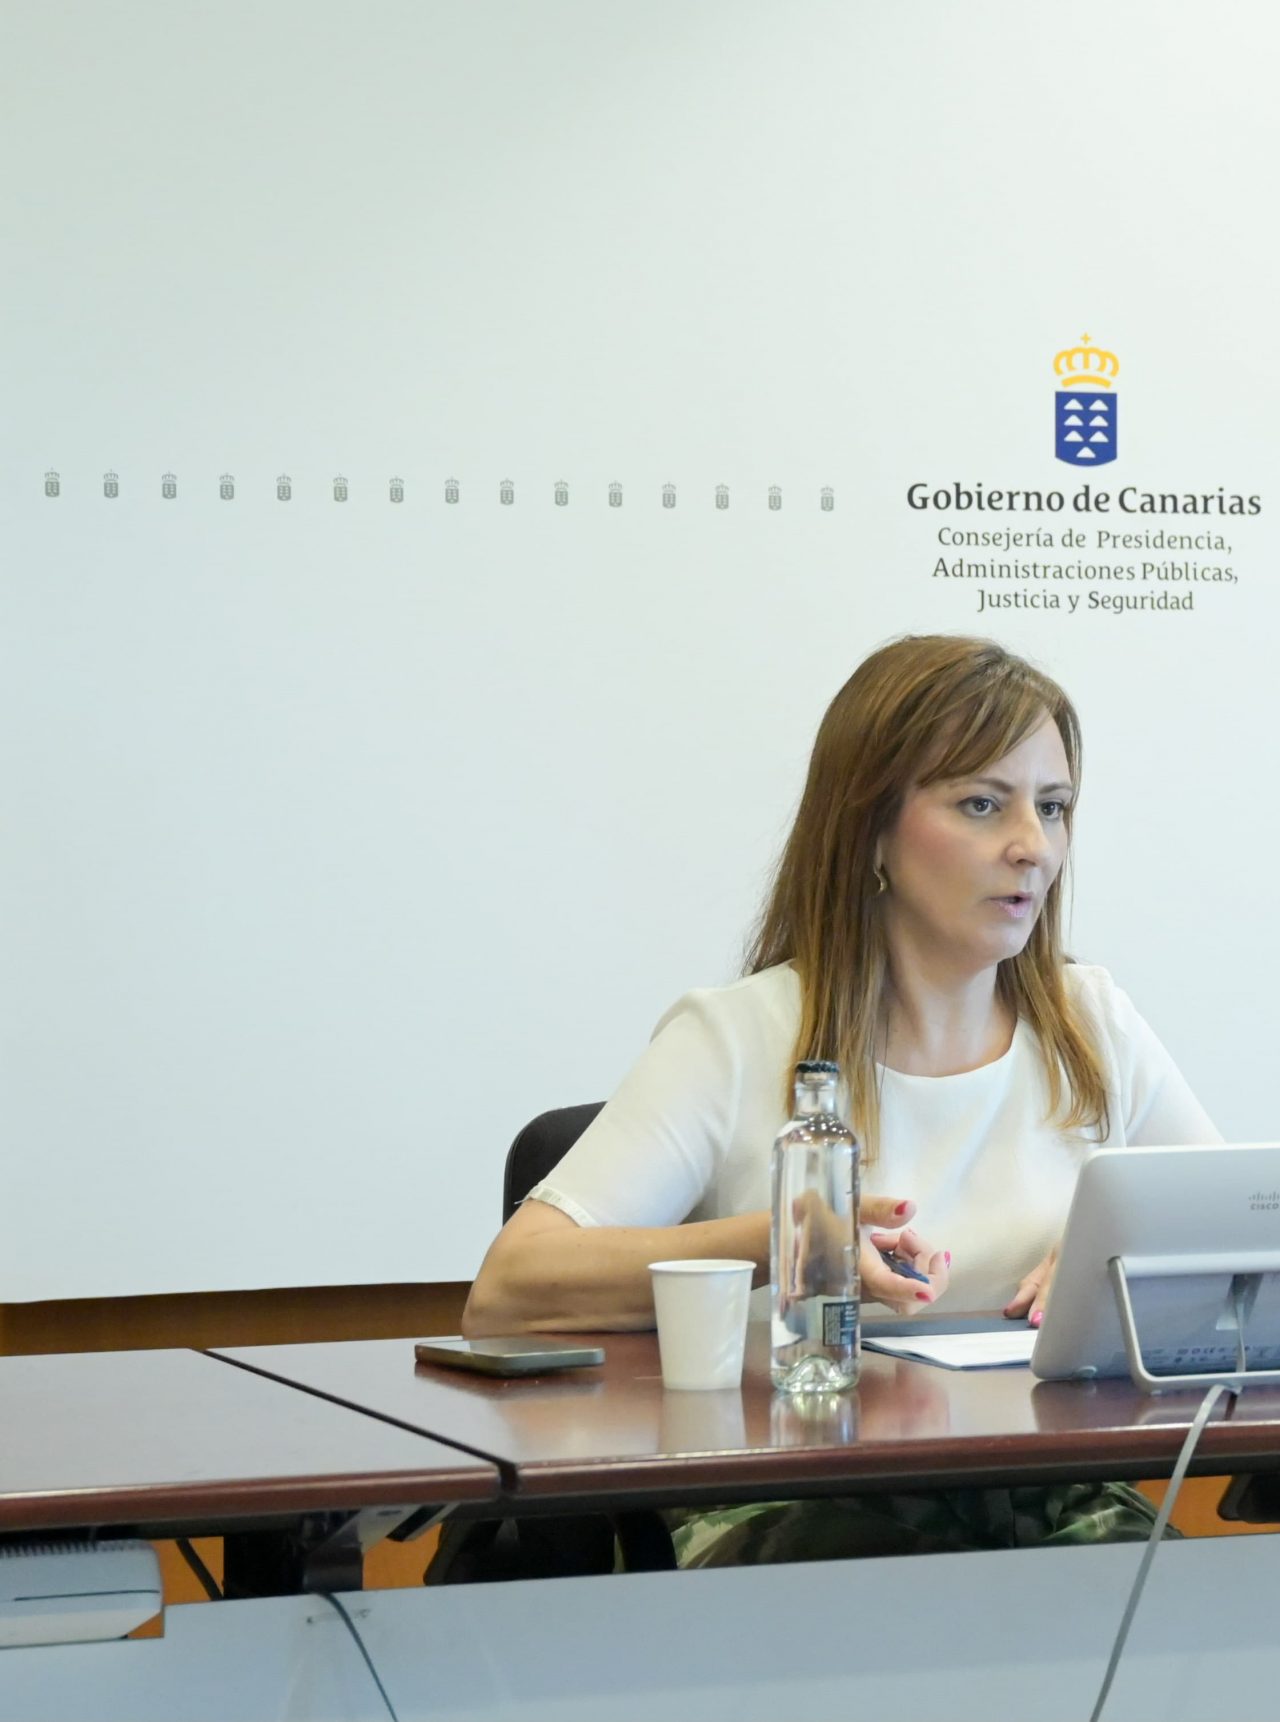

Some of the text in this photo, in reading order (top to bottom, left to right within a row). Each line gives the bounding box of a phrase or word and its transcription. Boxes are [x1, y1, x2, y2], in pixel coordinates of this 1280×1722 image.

[906, 482, 1262, 515] Gobierno de Canarias
[937, 527, 1232, 554] Consejería de Presidencia,
[932, 558, 1238, 584] Administraciones Públicas,
[977, 589, 1194, 615] Justicia y Seguridad
